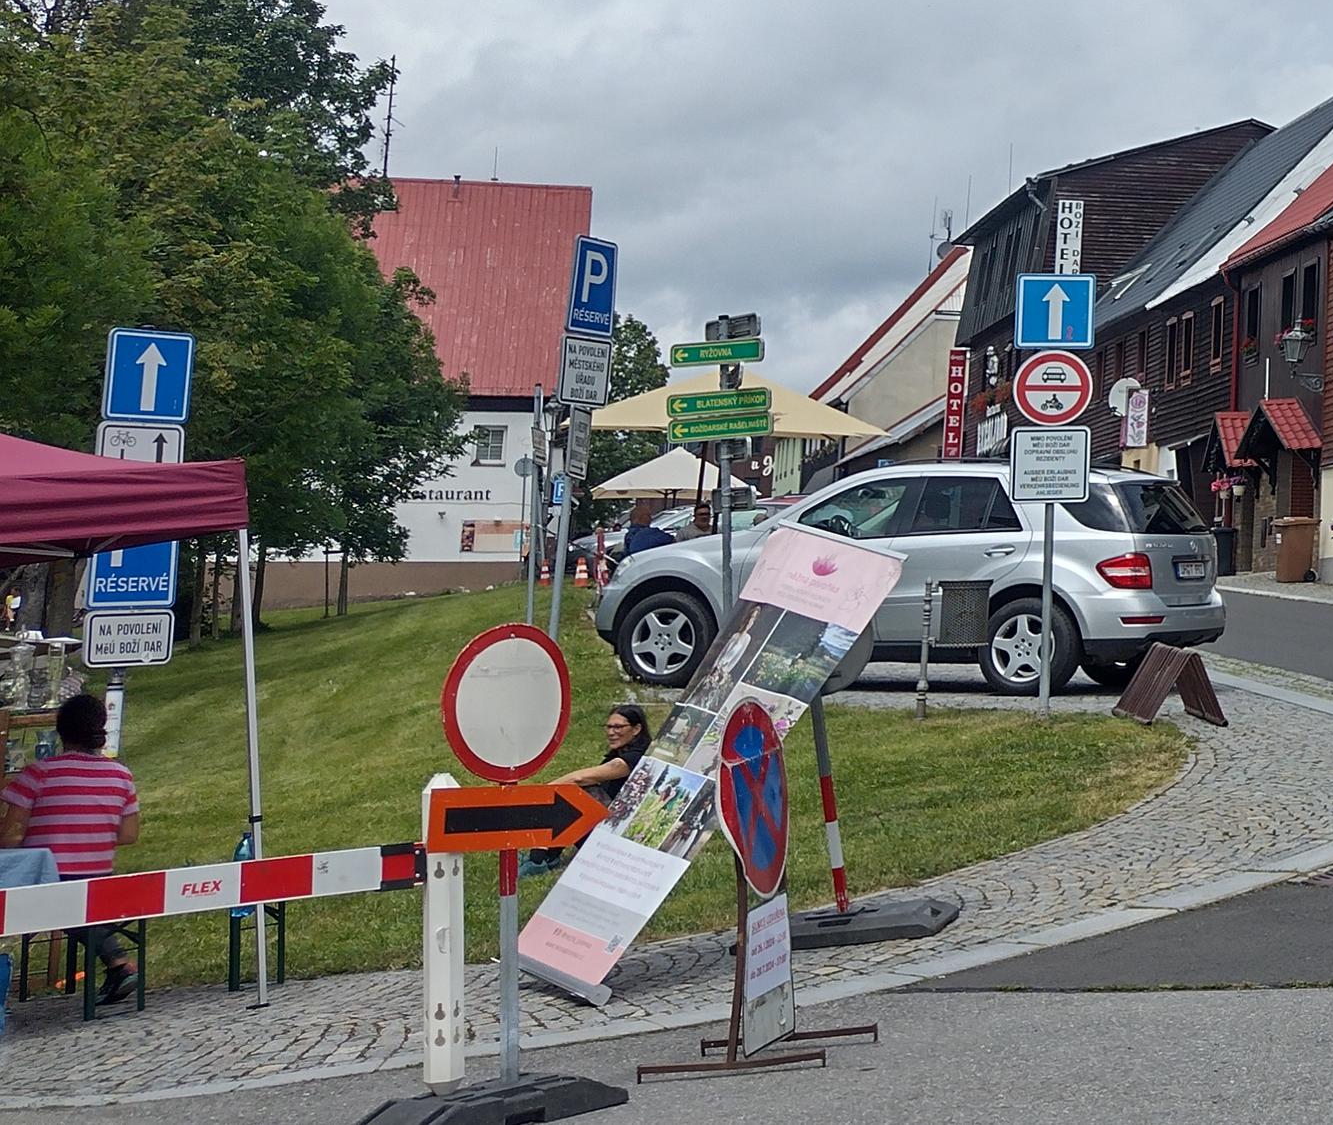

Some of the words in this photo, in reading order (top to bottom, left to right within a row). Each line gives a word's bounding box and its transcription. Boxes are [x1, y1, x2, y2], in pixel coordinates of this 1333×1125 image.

[581, 250, 608, 302] P
[572, 307, 610, 325] RÉSERVÉ
[568, 343, 577, 354] NA
[578, 345, 608, 358] POVOLENÍ
[585, 389, 597, 401] DAR
[947, 366, 964, 444] HOTEL
[410, 488, 491, 501] estaurant
[95, 572, 169, 593] RÉSERVÉ
[99, 624, 112, 636] NA
[117, 619, 163, 635] POVOLENÍ
[120, 638, 141, 654] BOŽÍ
[181, 879, 222, 896] FLEX
